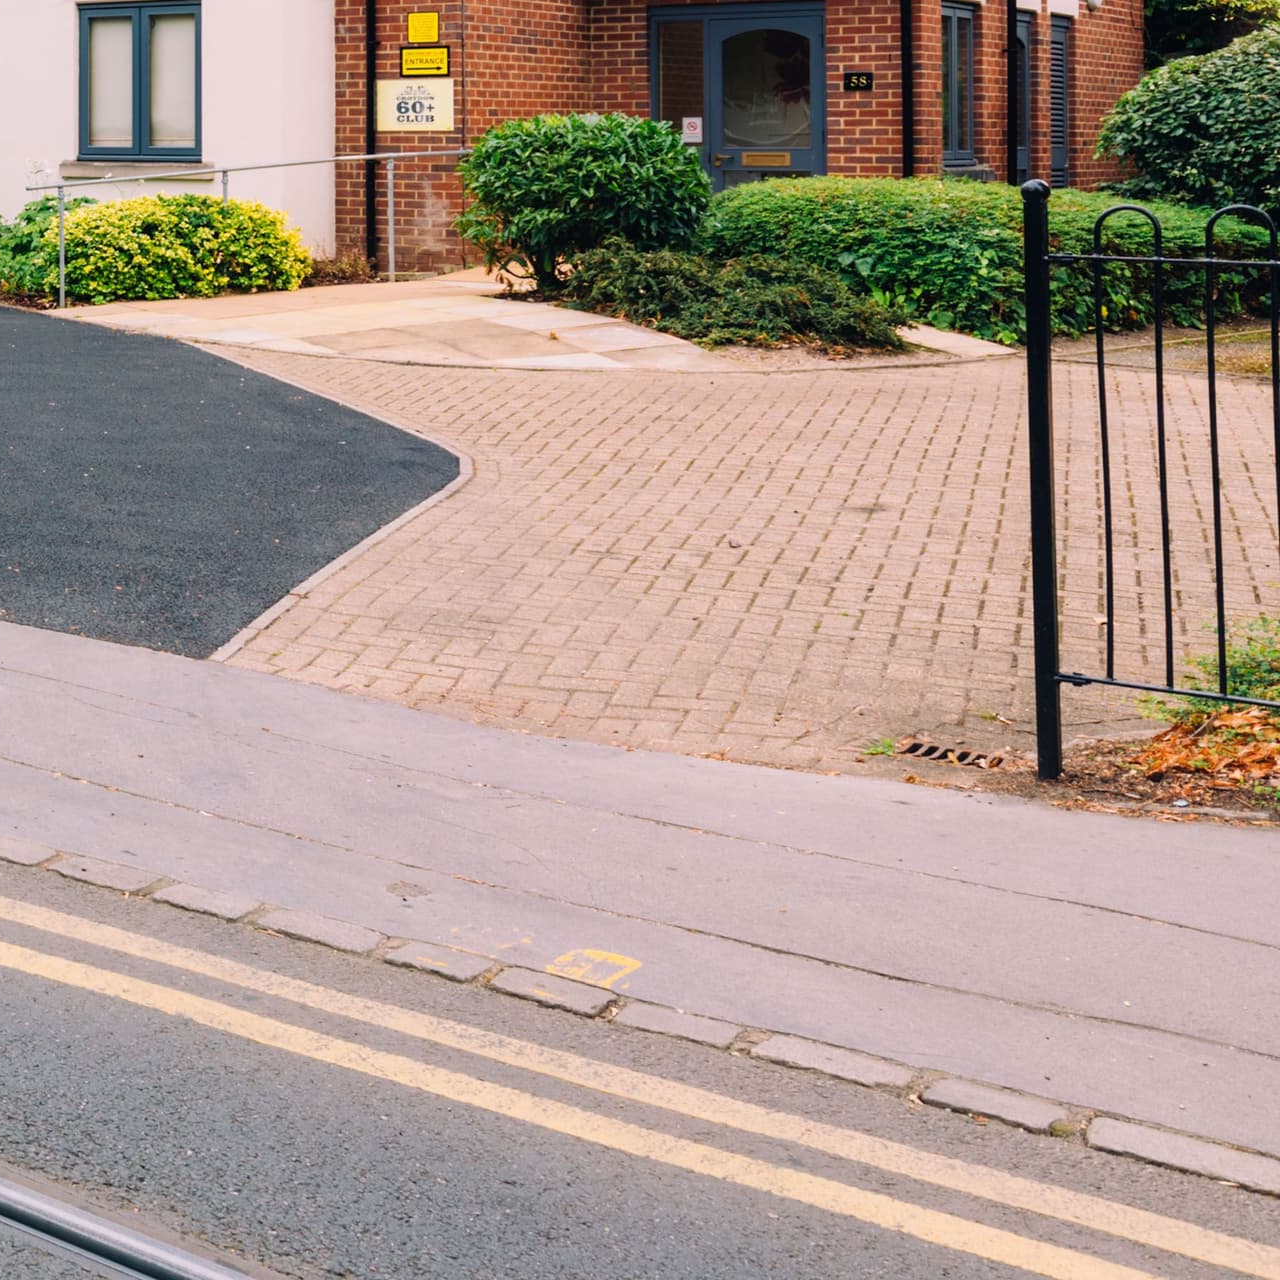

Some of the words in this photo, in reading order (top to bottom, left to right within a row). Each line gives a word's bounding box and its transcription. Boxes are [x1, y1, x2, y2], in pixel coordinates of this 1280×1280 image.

[404, 57, 445, 66] ENTRANCE
[850, 75, 867, 87] 58
[396, 101, 435, 114] 60+
[396, 115, 435, 123] CLUB
